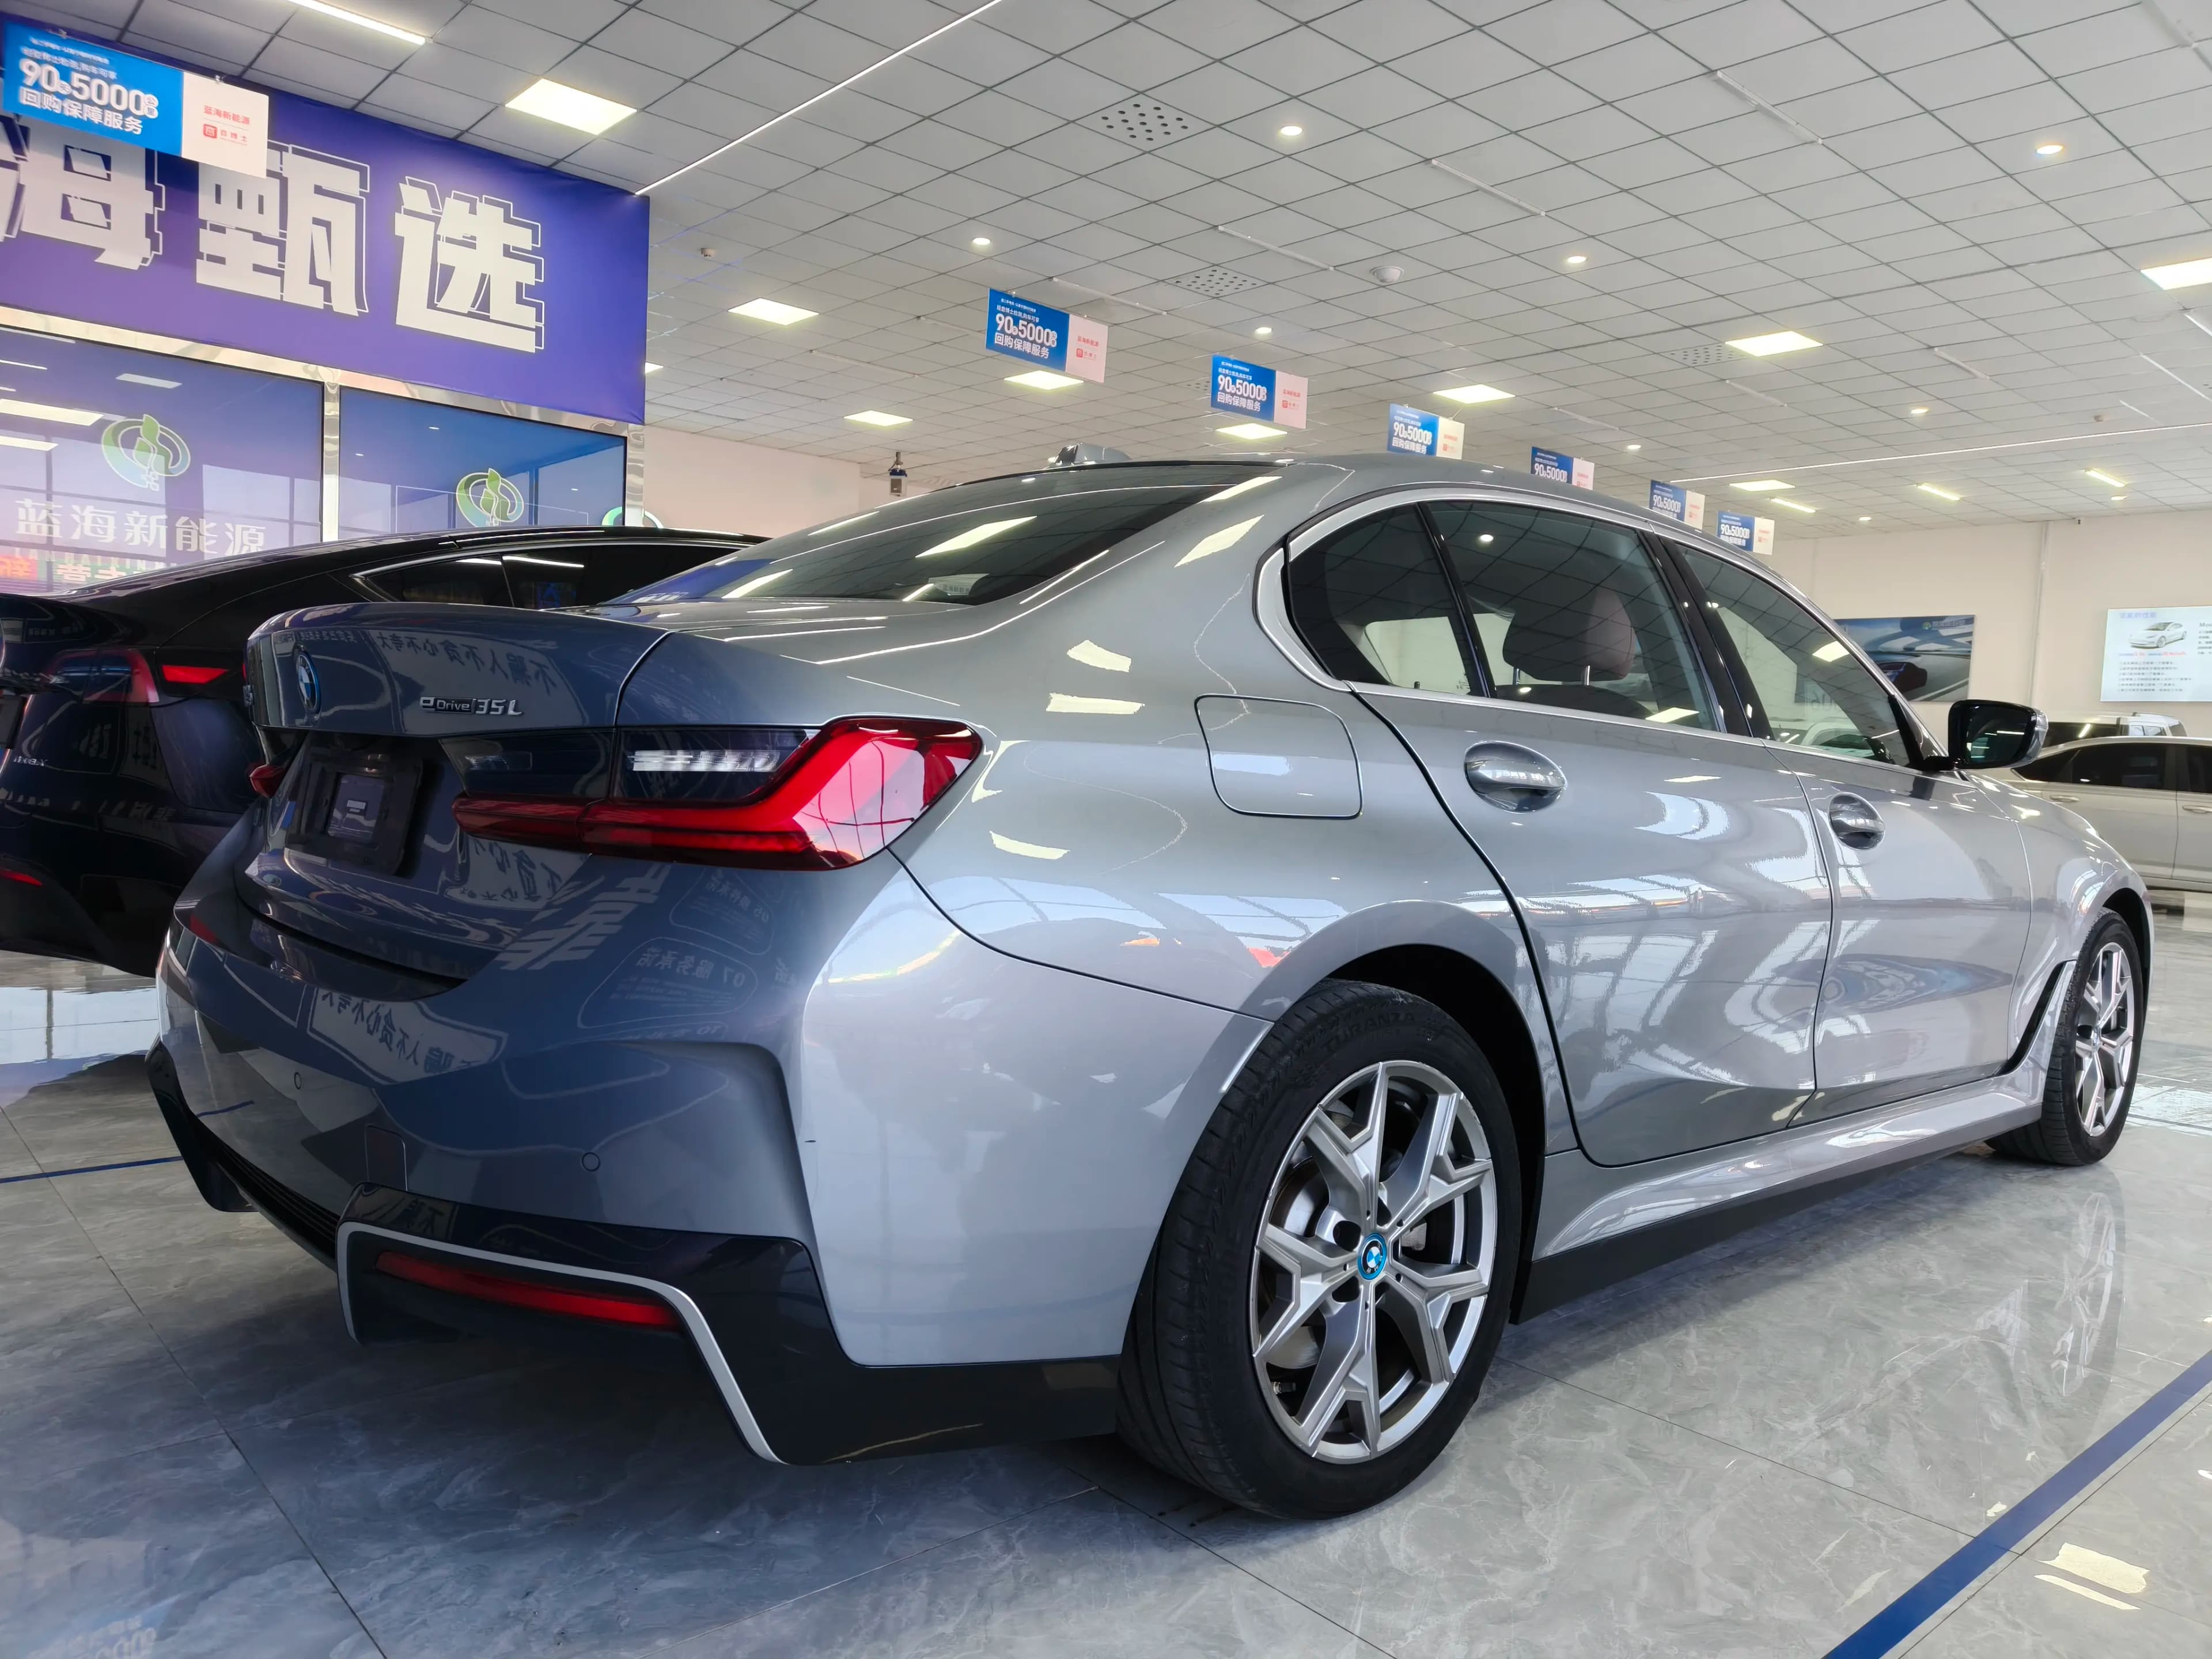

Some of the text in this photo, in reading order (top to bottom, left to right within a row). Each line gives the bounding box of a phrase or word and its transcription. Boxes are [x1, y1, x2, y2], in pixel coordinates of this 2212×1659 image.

[18, 86, 143, 135] 回购保障服务
[203, 105, 250, 125] 蓝海新能源
[994, 332, 1050, 359] 回购保障服务
[1217, 392, 1261, 412] 回购保障服务
[14, 498, 267, 555] 蓝海新能源
